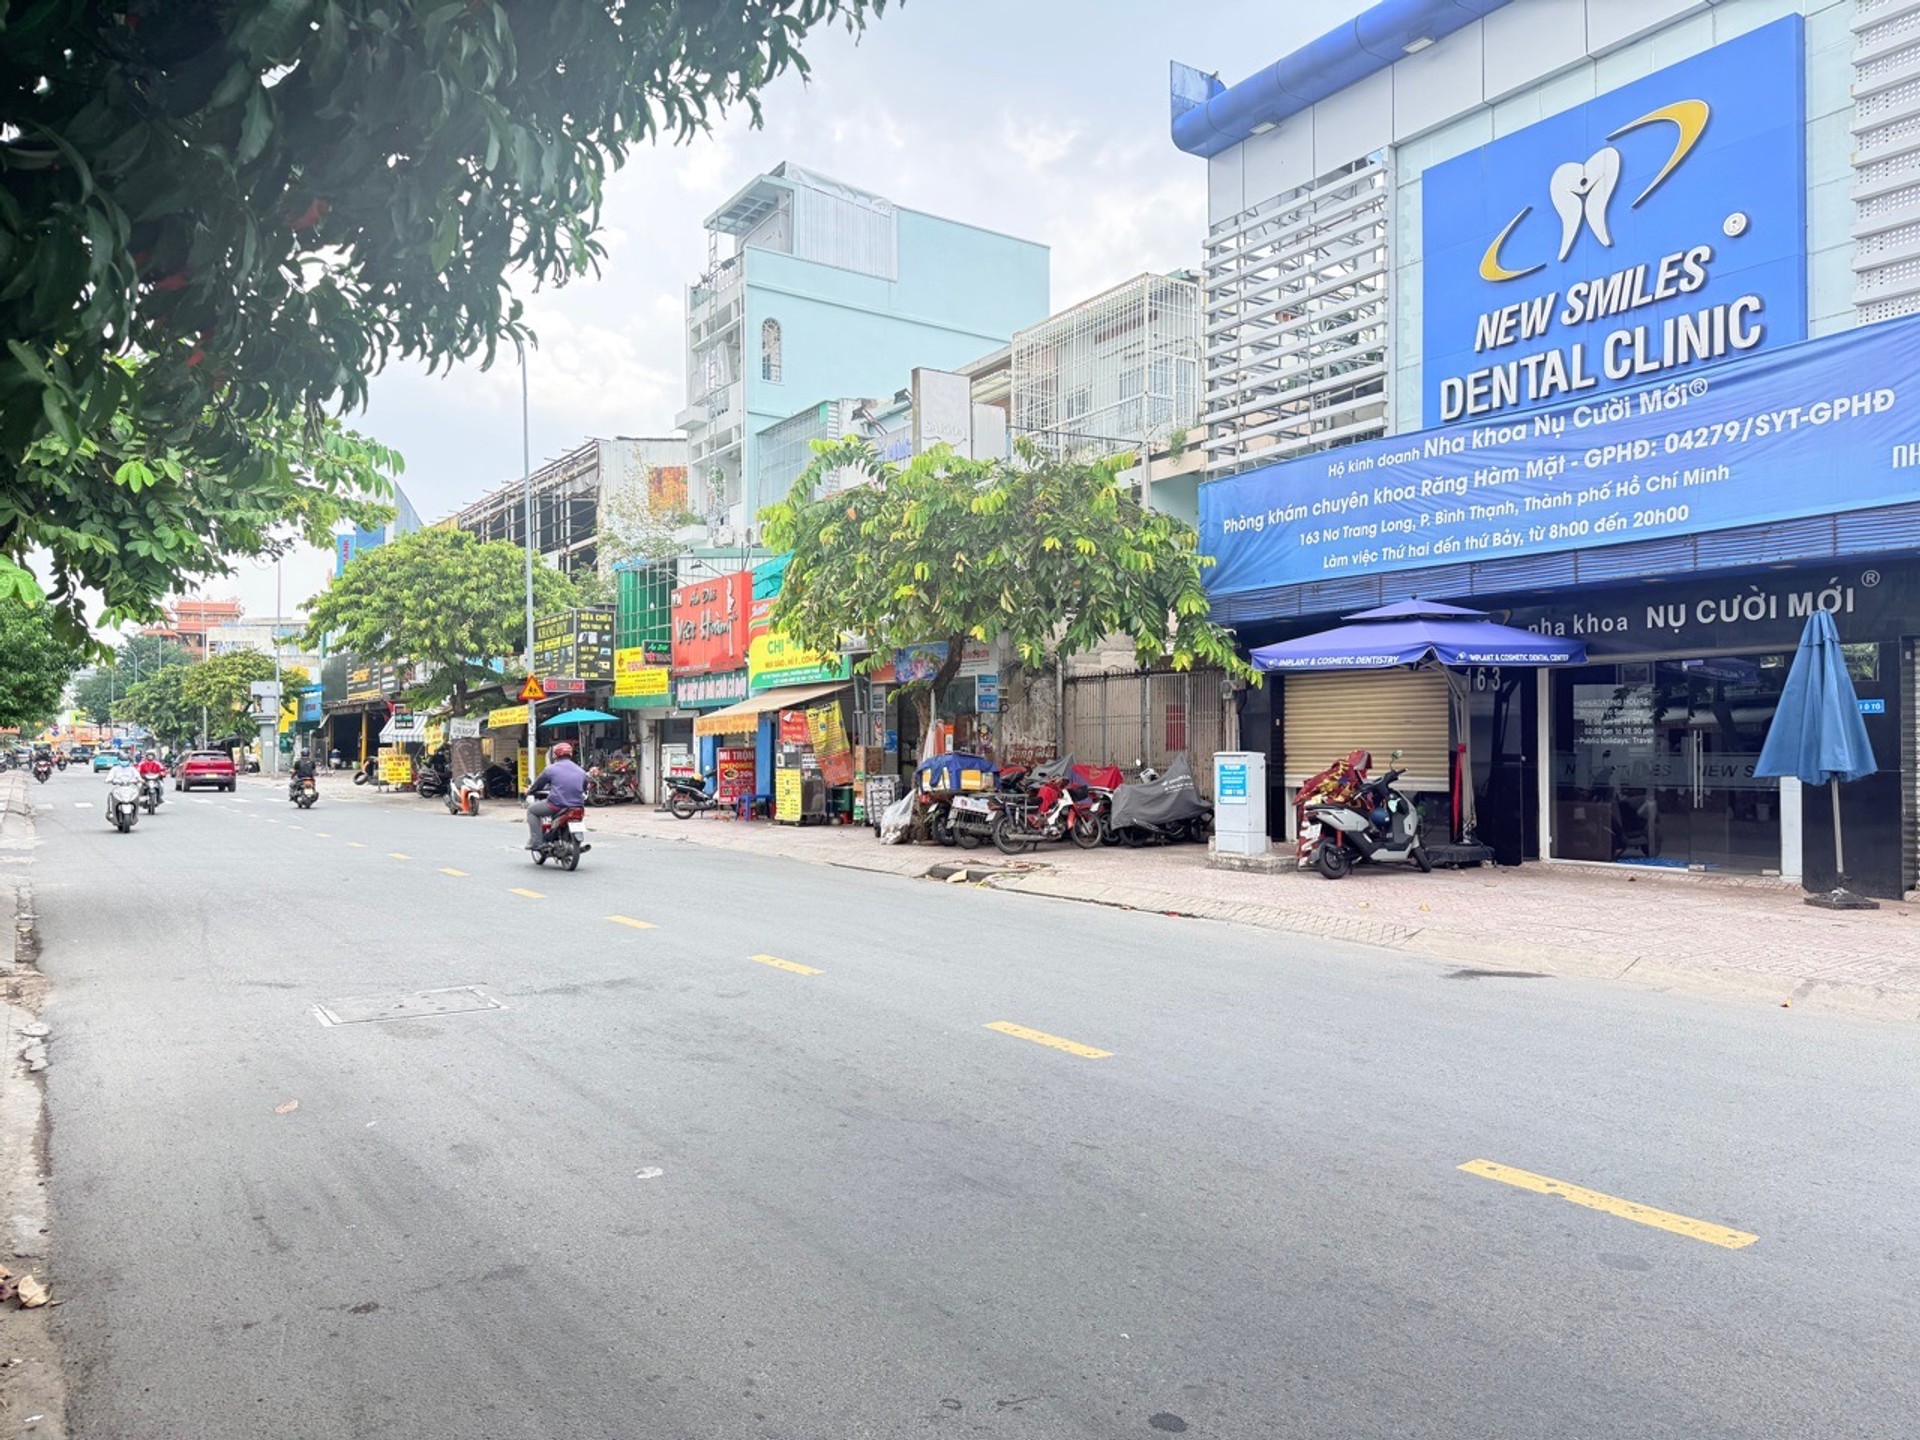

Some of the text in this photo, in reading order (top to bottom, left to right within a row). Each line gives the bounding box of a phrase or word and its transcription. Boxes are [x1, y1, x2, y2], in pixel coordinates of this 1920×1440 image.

[1474, 245, 1713, 352] NEW SMILES
[1440, 295, 1764, 422] DENTAL CLINIC
[1223, 513, 1265, 535] Phòng
[1268, 506, 1308, 526] khám
[1312, 492, 1368, 515] chuyên
[1374, 485, 1416, 505] khoa
[1421, 475, 1468, 498] Răng
[1473, 466, 1520, 489] Hàm
[1526, 456, 1566, 481] Mặt
[1584, 440, 1657, 469] GPHĐ:
[1664, 388, 1896, 455] 04279/SYT-GPHĐ
[1328, 464, 1345, 480] Hộ
[1348, 458, 1374, 474] kinh
[1378, 448, 1420, 467] doanh
[1424, 434, 1465, 459] Nha
[1472, 424, 1527, 450] khoa
[1533, 413, 1565, 439] Nụ
[1573, 397, 1631, 428] Cười
[1299, 464, 1730, 546] 163 Nơ Trang Long, P. Bình Thạnh, Thành phố Hồ Chí Minh
[1323, 504, 1690, 569] Làm việc Thứ hai đến thứ Bảy, từ 8h00 đến 20h00
[1528, 617, 1566, 638] nha
[1573, 614, 1629, 635] khoa
[1646, 604, 1687, 634] NỤ
[1696, 584, 1778, 625] CƯỜI
[1787, 577, 1855, 617] MỚI
[1465, 666, 1502, 693] 163
